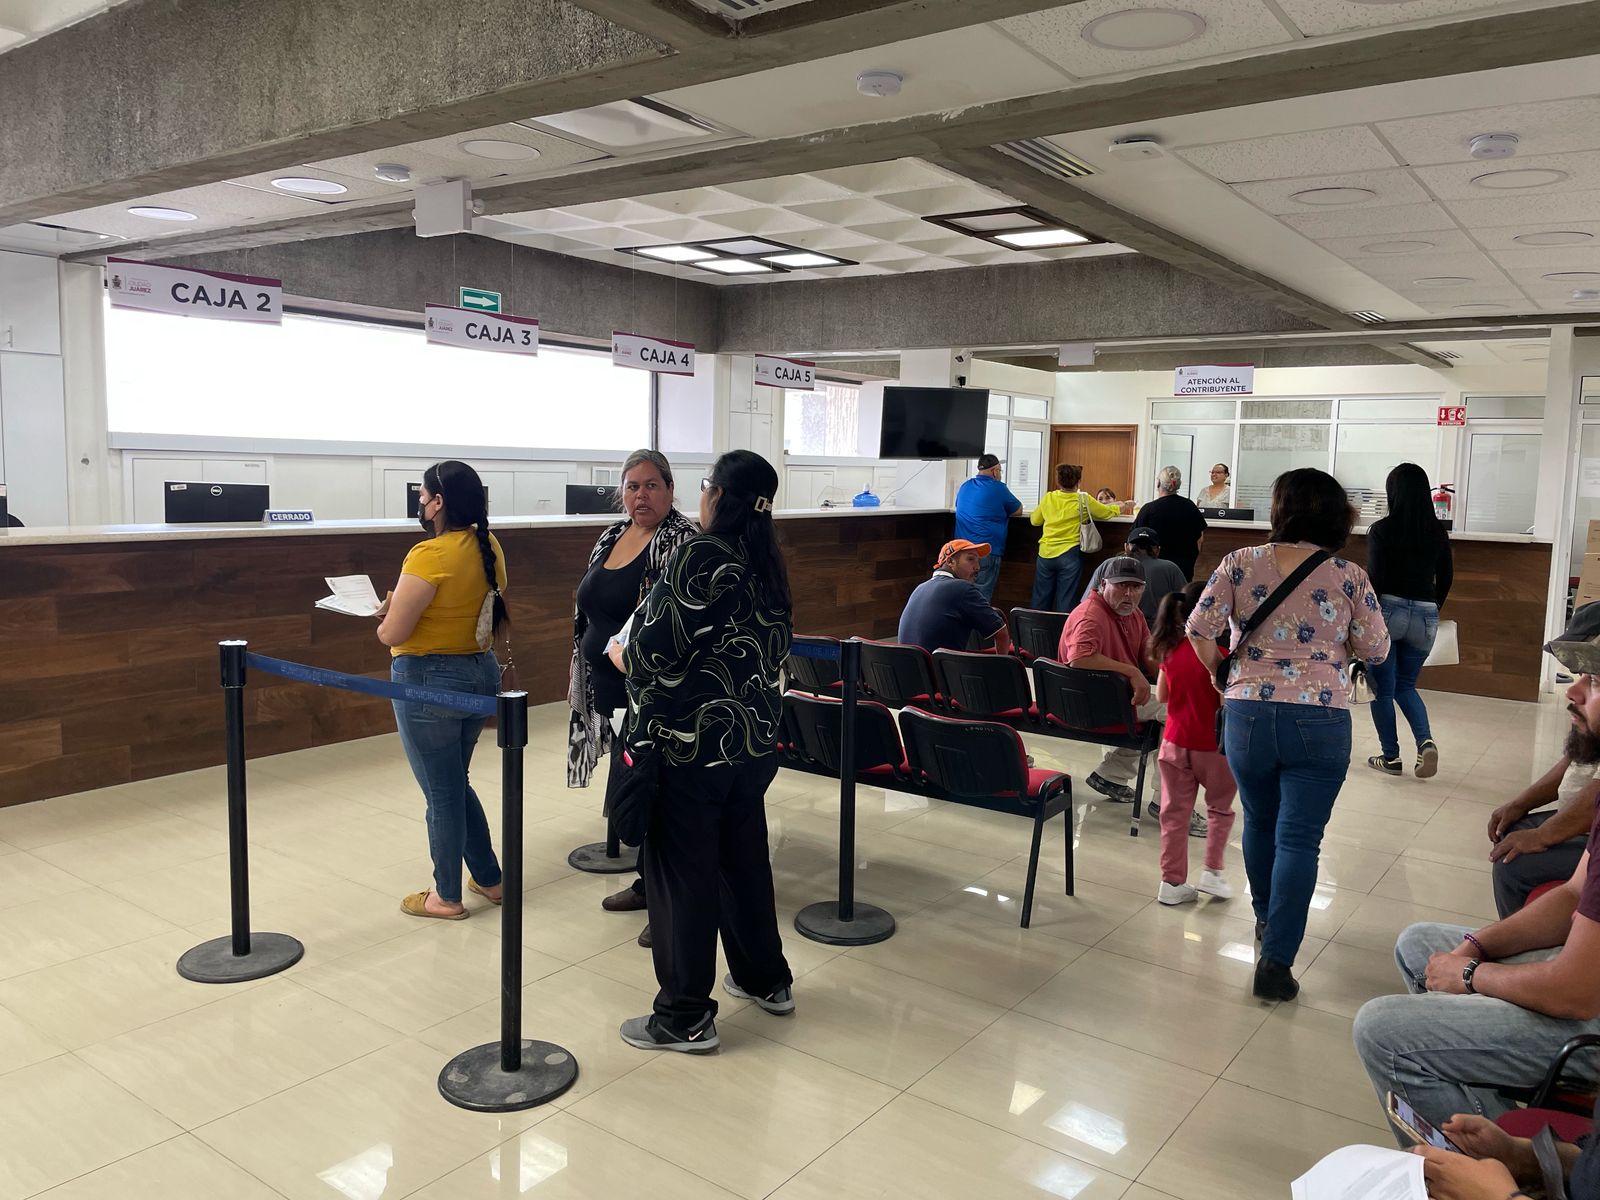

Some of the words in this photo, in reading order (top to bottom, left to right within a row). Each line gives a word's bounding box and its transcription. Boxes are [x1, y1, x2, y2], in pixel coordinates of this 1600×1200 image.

[171, 282, 248, 310] CAJA
[256, 292, 271, 312] 2
[465, 322, 515, 344] CAJA
[521, 330, 531, 345] 3
[640, 347, 676, 365] CAJA
[681, 353, 689, 366] 4
[775, 366, 802, 382] CAJA
[805, 370, 811, 382] 5
[1187, 376, 1227, 385] ATENCIÓN
[1180, 385, 1247, 393] CONTRIBUYENTE
[271, 511, 311, 521] CERRADO
[443, 694, 453, 705] DE
